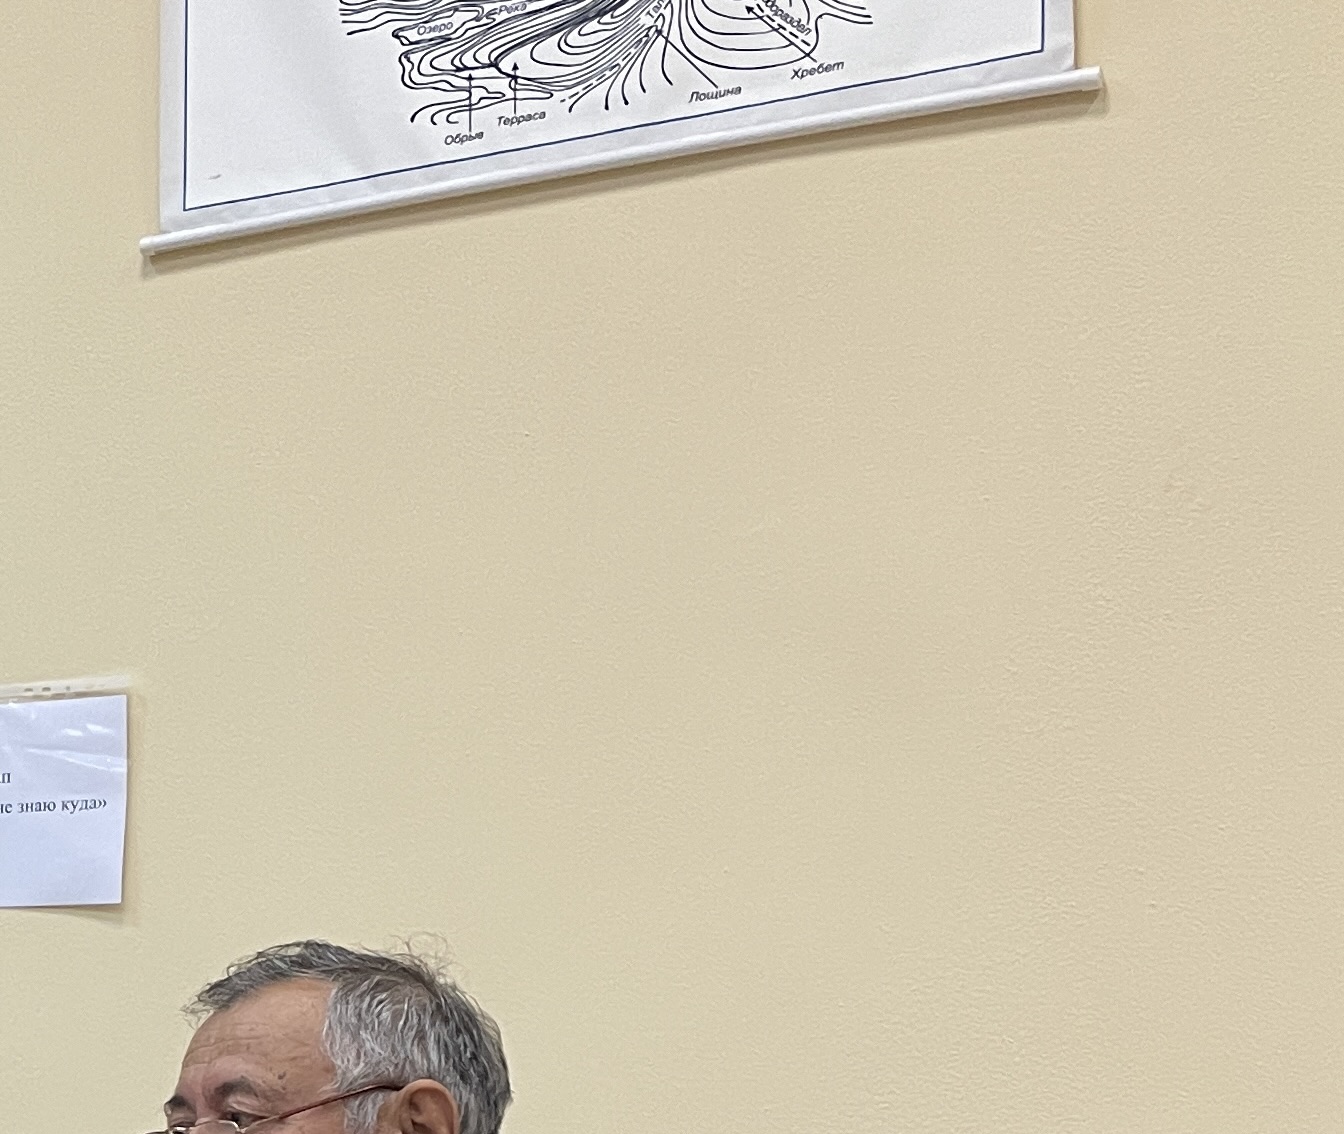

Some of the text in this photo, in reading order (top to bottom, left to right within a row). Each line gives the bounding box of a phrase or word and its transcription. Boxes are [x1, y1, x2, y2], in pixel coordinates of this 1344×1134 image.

[762, 0, 812, 36] дораздел
[417, 21, 454, 36] Озеро
[790, 61, 845, 81] Хребет
[688, 85, 742, 103] Лощина
[496, 110, 547, 127] Терраса
[444, 131, 484, 146] Обрыв
[17, 799, 57, 813] знаю
[61, 798, 108, 815] куда»
